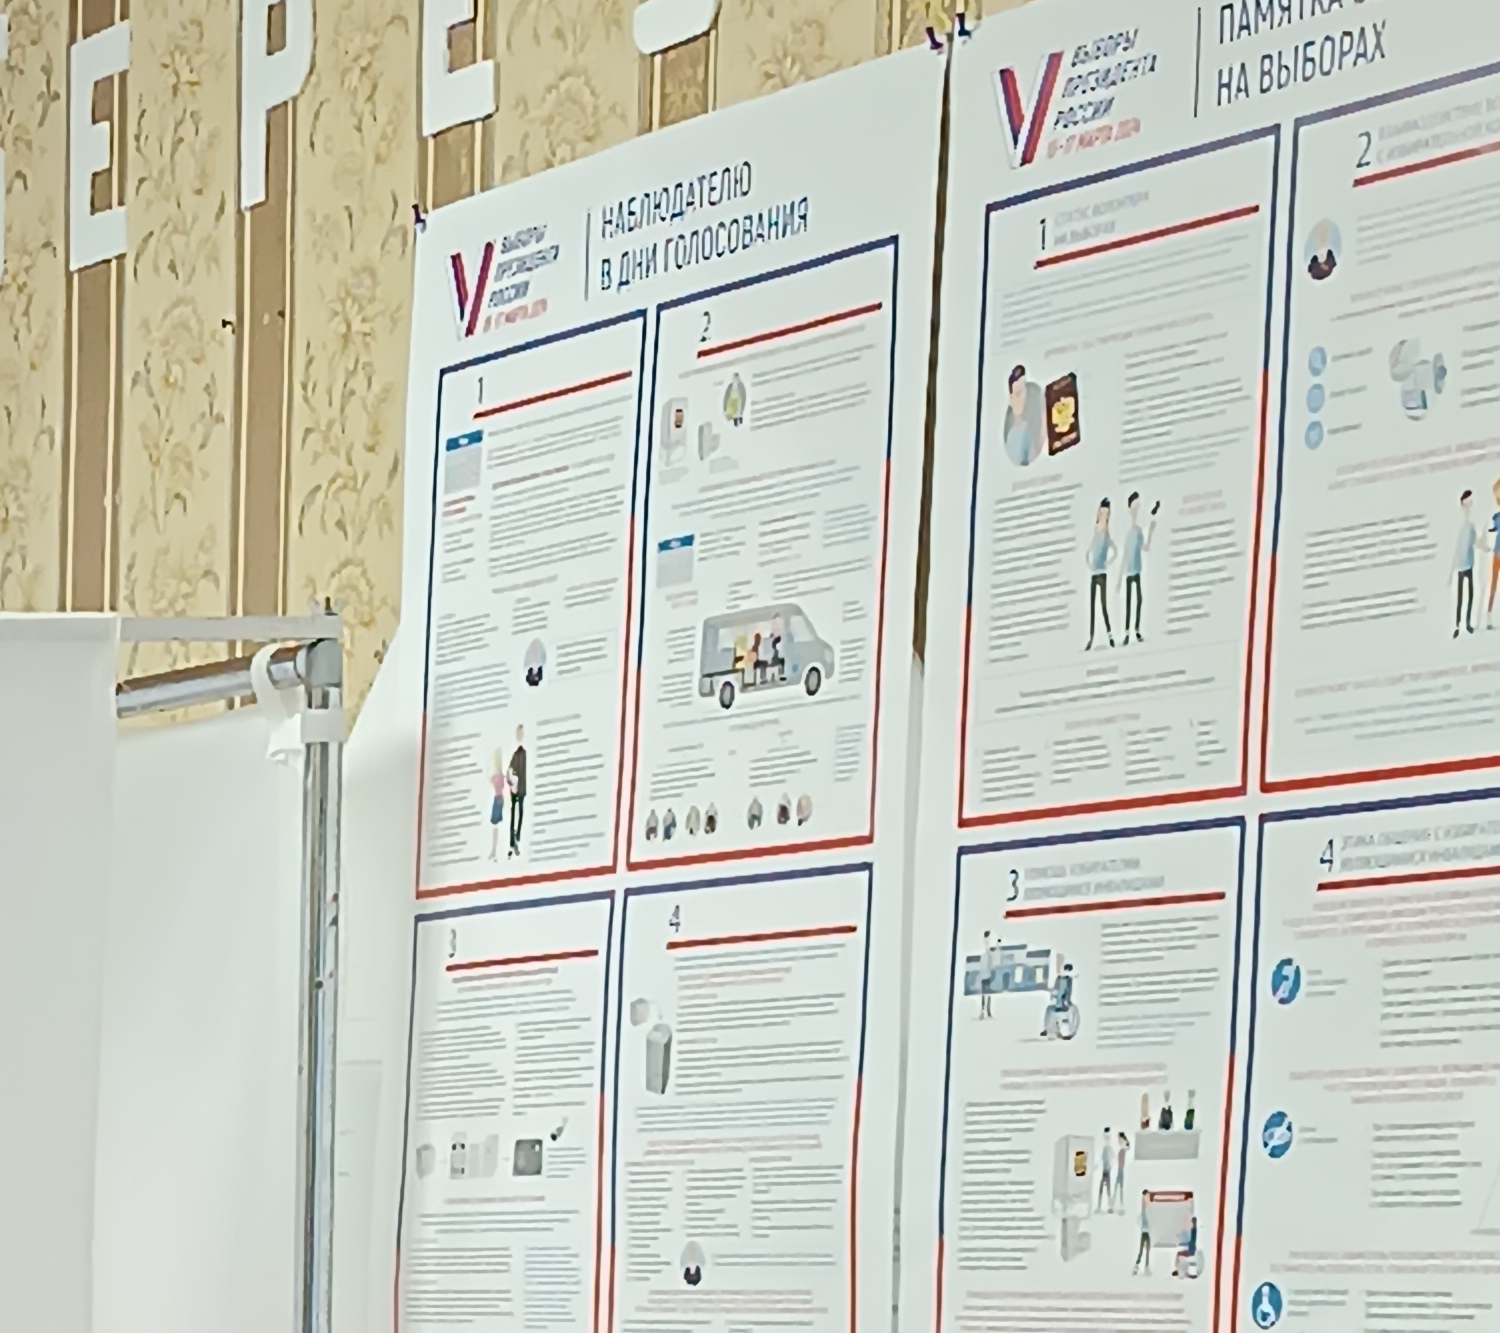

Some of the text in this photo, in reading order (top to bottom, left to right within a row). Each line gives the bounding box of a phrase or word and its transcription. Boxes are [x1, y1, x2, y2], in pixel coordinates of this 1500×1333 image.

[1218, 0, 1343, 44] ПАМЯ
[1216, 19, 1386, 107] НА ВЫБОРАХ
[1356, 131, 1372, 168] 2
[601, 161, 753, 240] НАБЛЮДАТЕЛЮ
[601, 196, 809, 293] В ДНИ ГОЛОСОВАНИЯ
[1040, 217, 1047, 250] 1
[699, 310, 712, 343] 2
[477, 376, 484, 405] 1
[1319, 838, 1334, 873] 4
[1006, 868, 1020, 902] 3
[668, 904, 681, 933] 4
